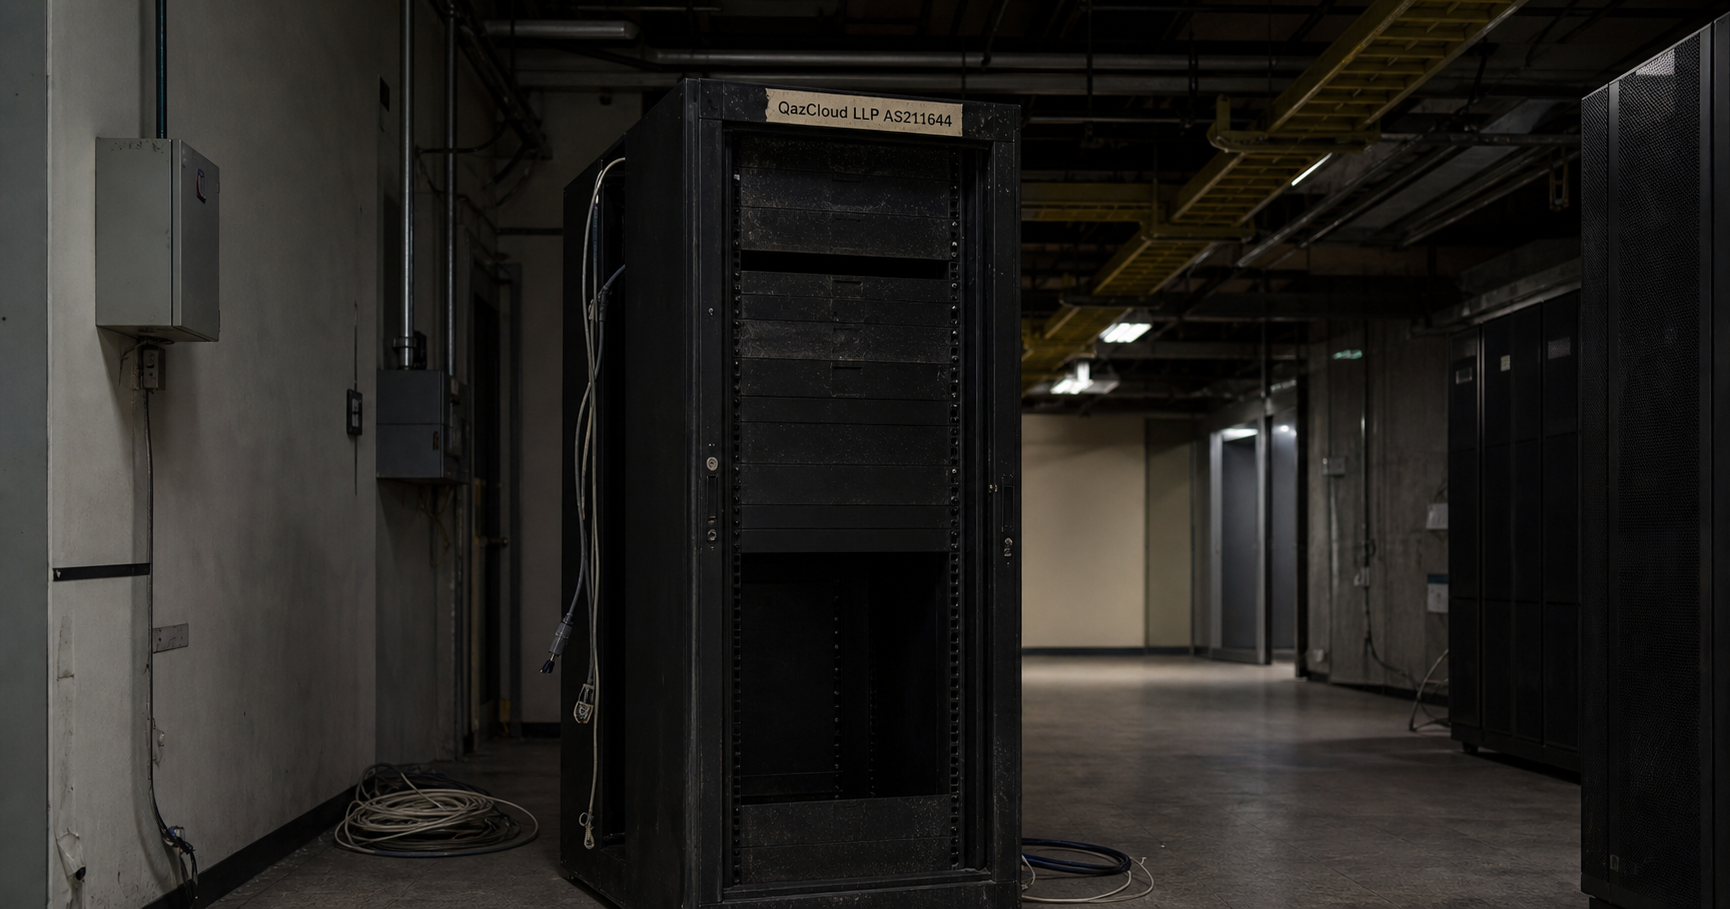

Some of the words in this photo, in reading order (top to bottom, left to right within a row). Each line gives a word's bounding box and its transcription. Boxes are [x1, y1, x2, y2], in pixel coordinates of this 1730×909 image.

[778, 101, 848, 119] QazCloud
[853, 107, 880, 121] LLP
[883, 110, 953, 127] AS211644
